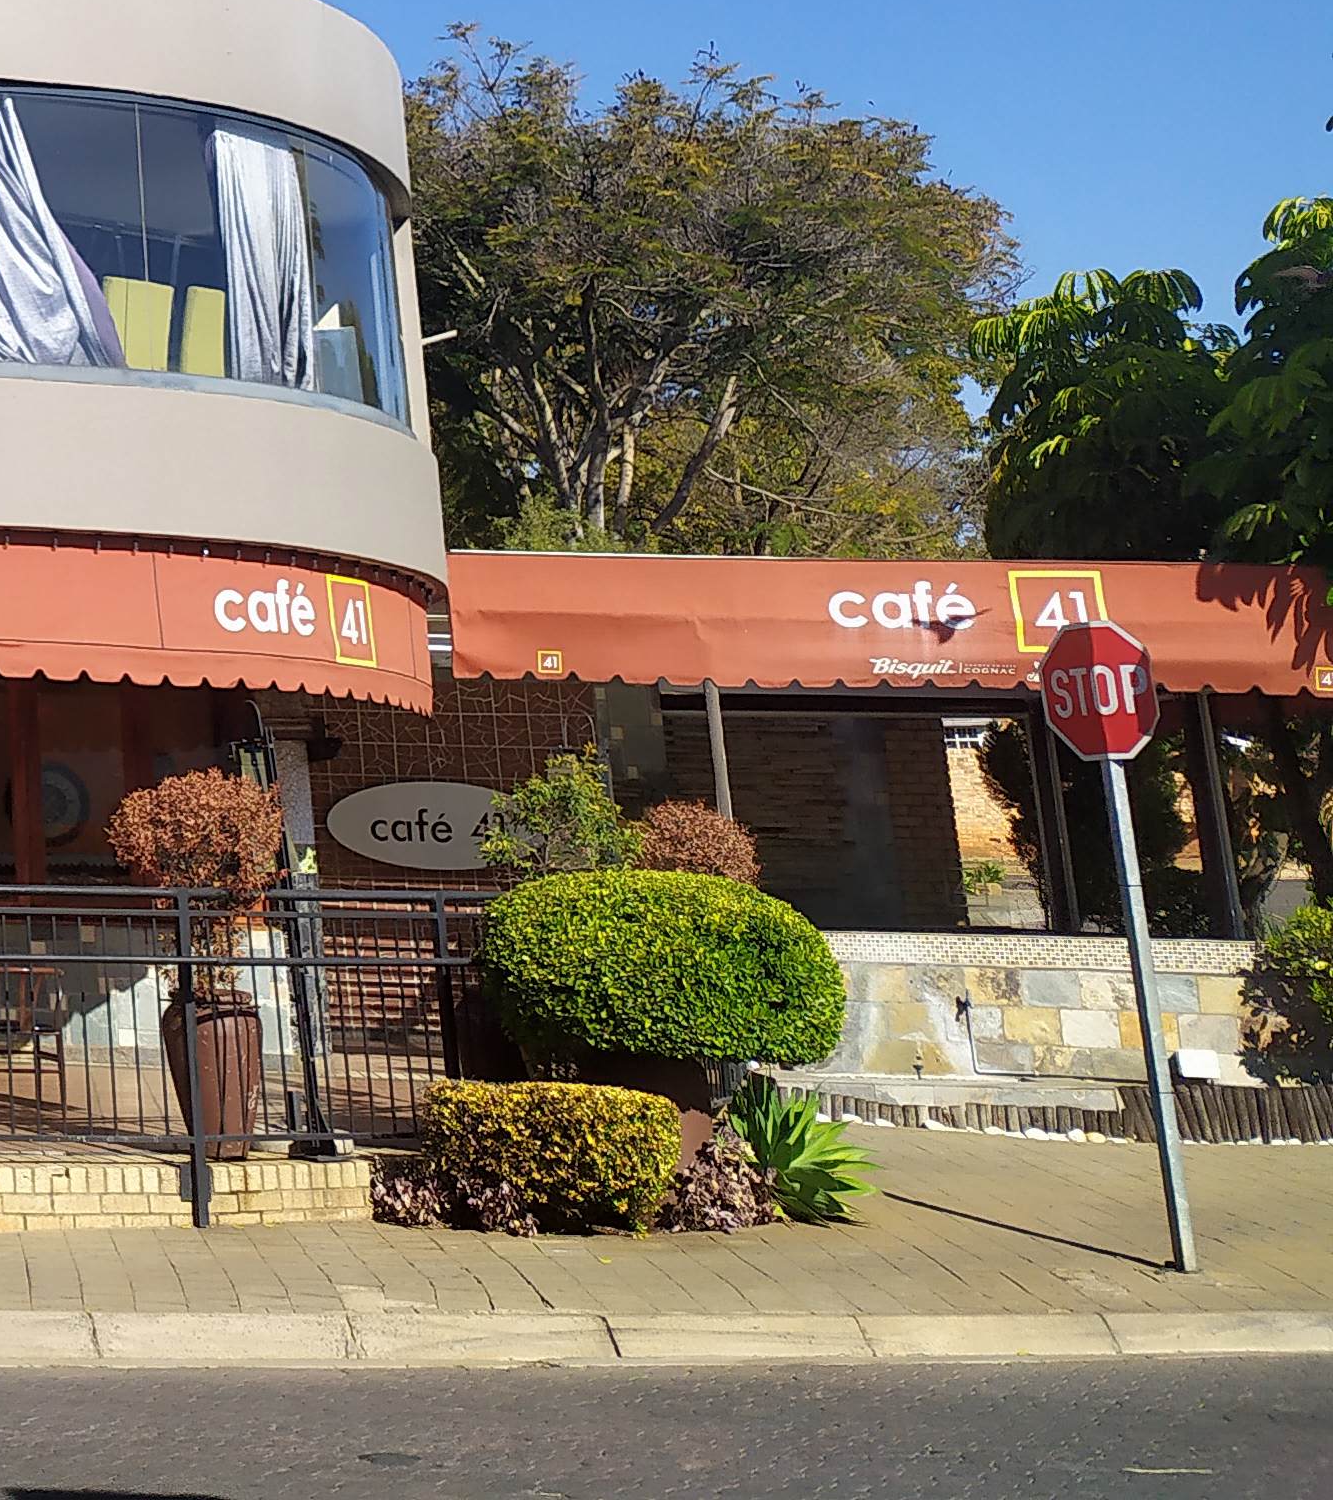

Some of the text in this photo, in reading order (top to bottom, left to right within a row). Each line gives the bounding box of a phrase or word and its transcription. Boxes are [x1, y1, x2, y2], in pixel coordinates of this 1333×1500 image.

[214, 578, 368, 645] café 41
[828, 579, 1088, 631] café 41
[543, 656, 558, 669] 41
[869, 657, 1016, 680] Bisquit COGNAC
[1321, 672, 1333, 686] 4
[1049, 663, 1148, 720] STOP
[370, 807, 454, 844] café
